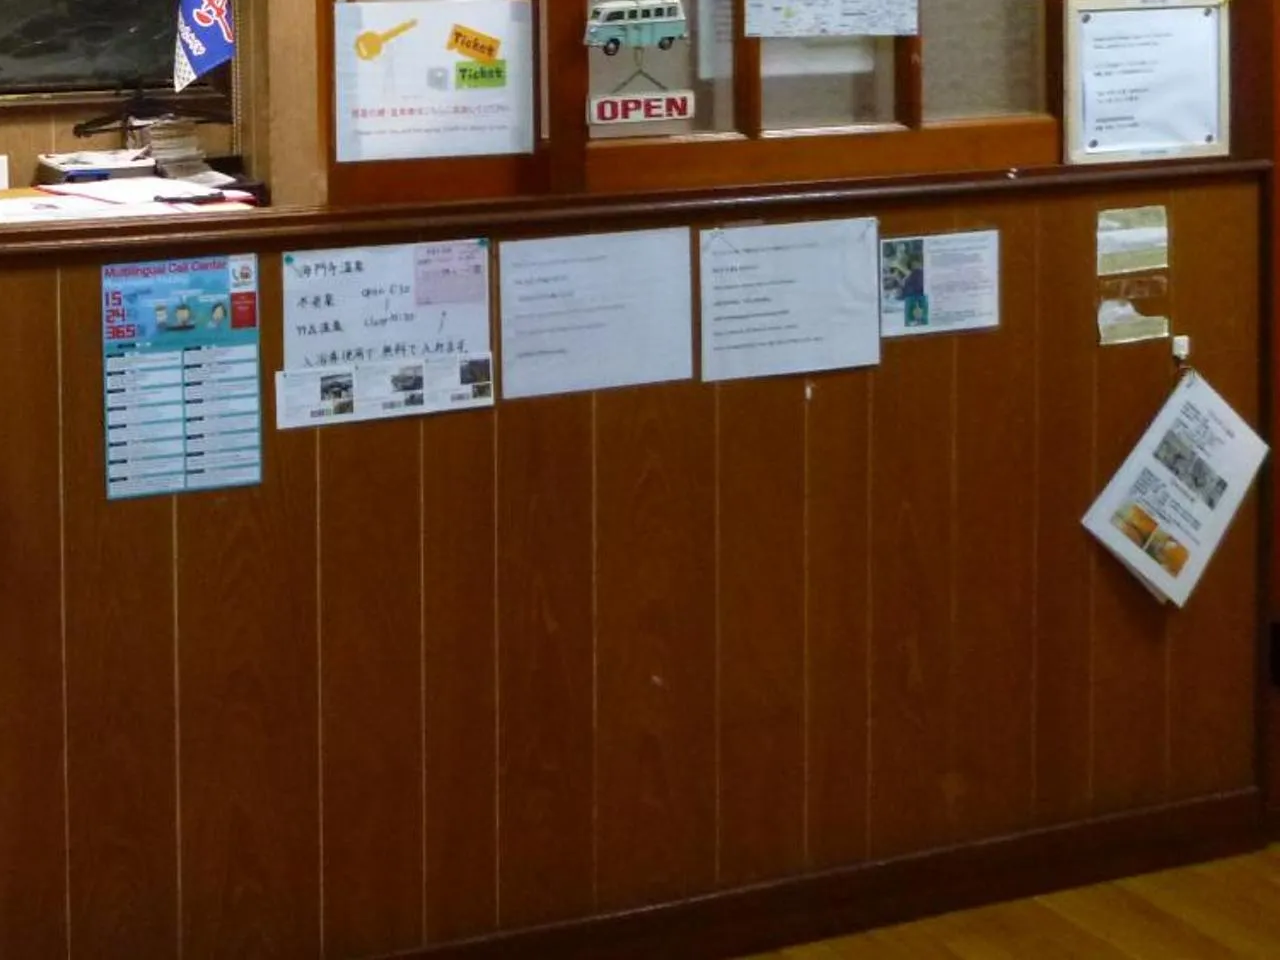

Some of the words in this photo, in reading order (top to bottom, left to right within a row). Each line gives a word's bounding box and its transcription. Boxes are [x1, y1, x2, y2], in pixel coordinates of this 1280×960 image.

[452, 30, 496, 57] Ticket
[459, 66, 504, 81] Ticket
[596, 95, 688, 121] OPEN
[104, 263, 166, 279] Multilingual
[167, 260, 188, 274] Call
[190, 257, 228, 272] Center
[104, 290, 123, 308] 15
[104, 307, 126, 324] 24
[105, 323, 136, 341] 365
